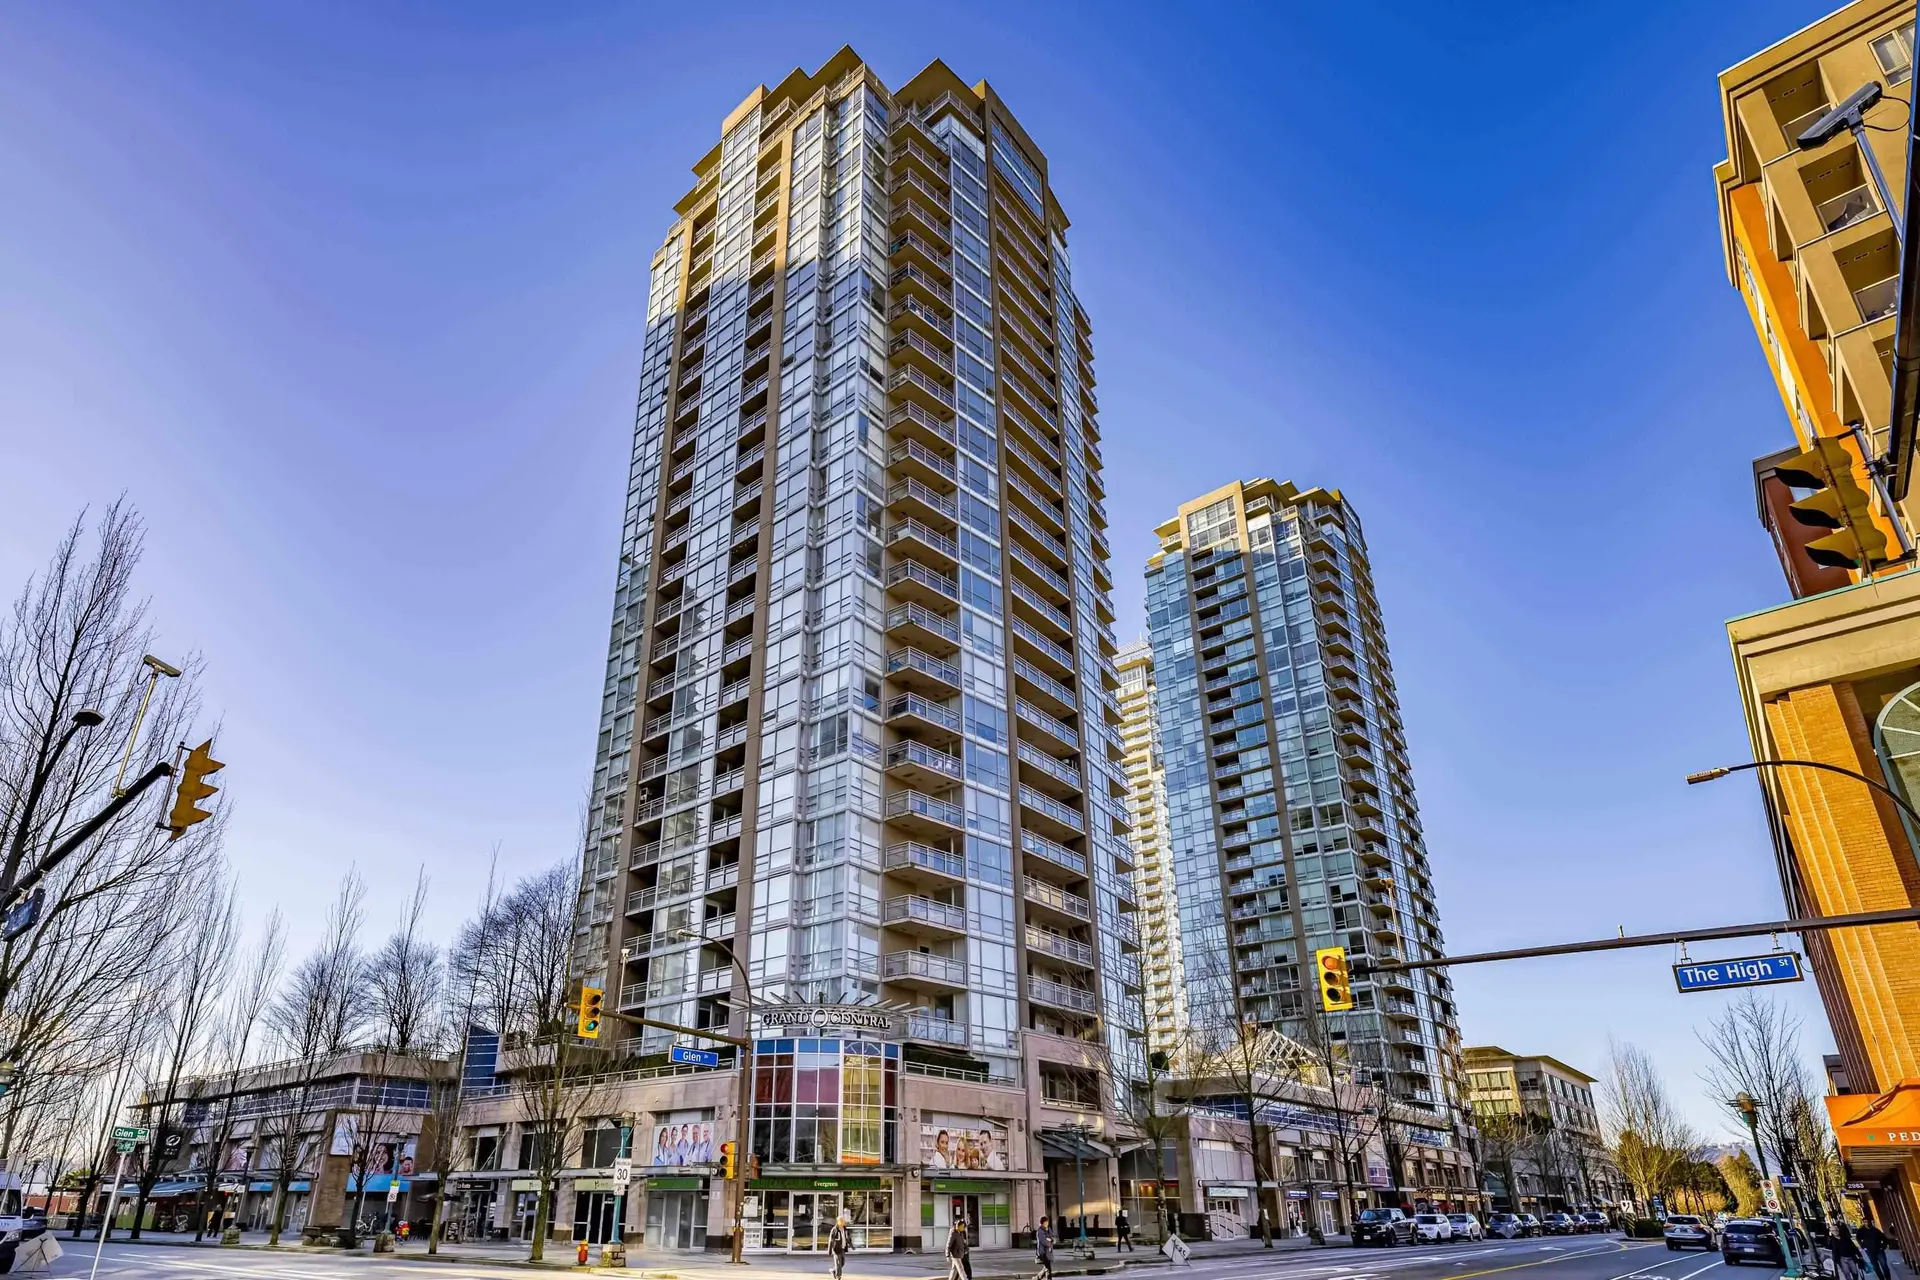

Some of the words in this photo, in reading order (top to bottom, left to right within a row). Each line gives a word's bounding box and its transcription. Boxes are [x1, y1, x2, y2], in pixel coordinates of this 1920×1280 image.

[1683, 968, 1720, 983] The
[1726, 960, 1772, 980] High
[1778, 958, 1789, 967] St
[762, 1011, 810, 1026] GRAND
[827, 1011, 891, 1030] CENTRAL
[682, 1052, 701, 1062] Glen
[115, 1128, 134, 1137] Glen
[617, 1168, 628, 1180] 30
